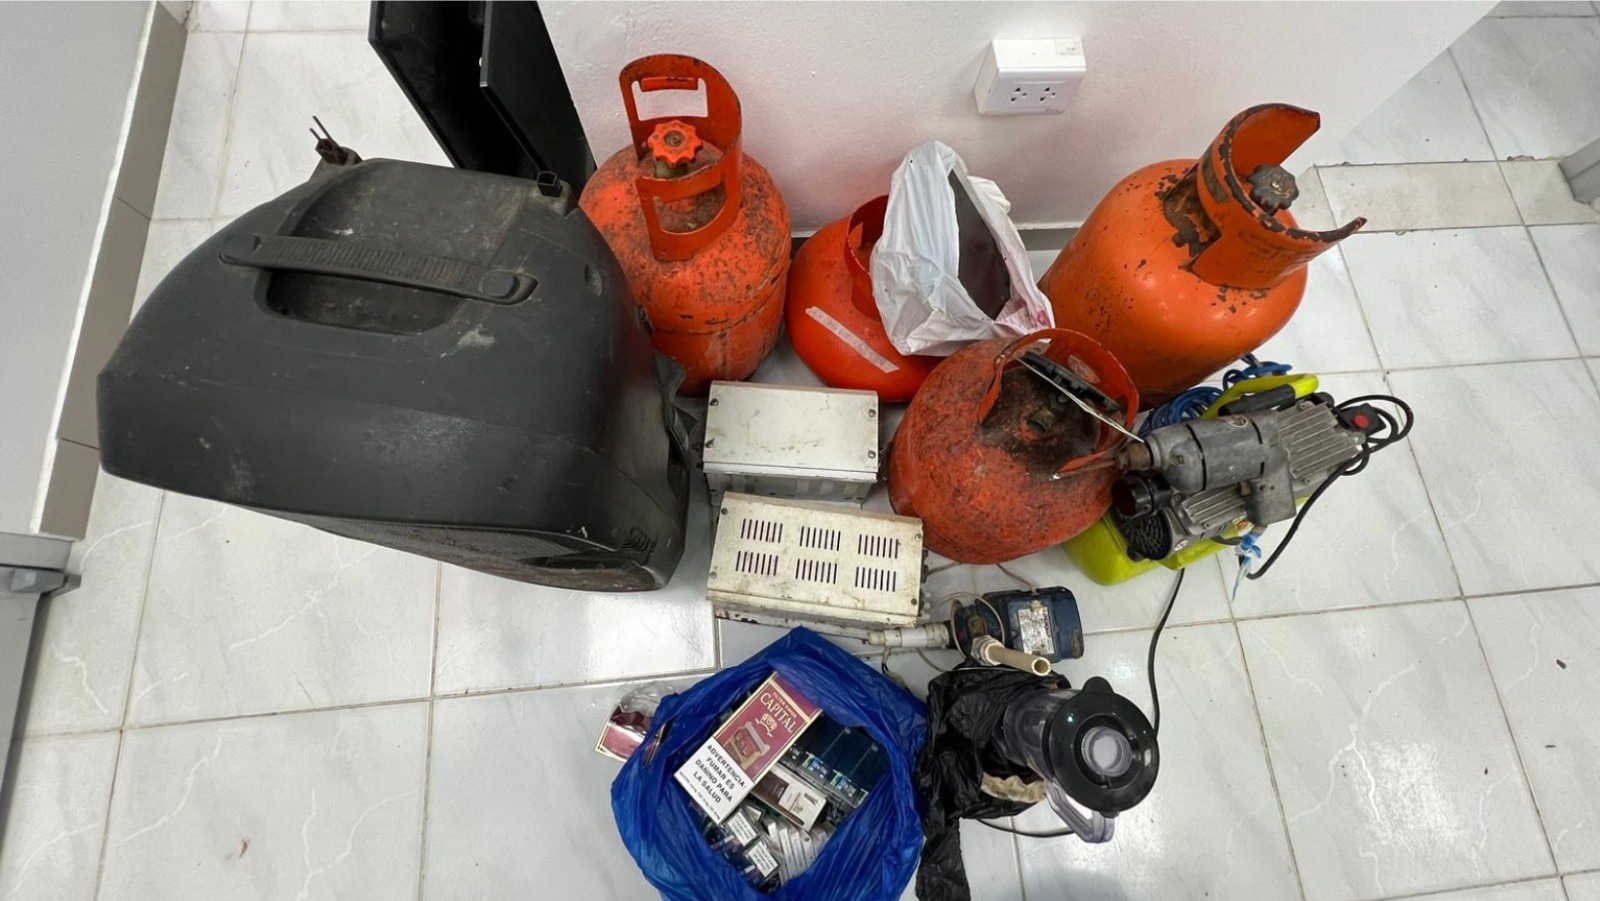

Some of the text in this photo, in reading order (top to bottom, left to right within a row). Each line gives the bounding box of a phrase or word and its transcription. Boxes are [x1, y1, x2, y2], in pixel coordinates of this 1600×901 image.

[760, 692, 797, 734] CAPITAL
[693, 771, 703, 782] LA
[701, 780, 722, 804] SALUD
[695, 759, 718, 784] DAÑINO
[716, 782, 734, 803] PARA
[706, 757, 727, 780] FUMAR
[725, 778, 736, 790] ES
